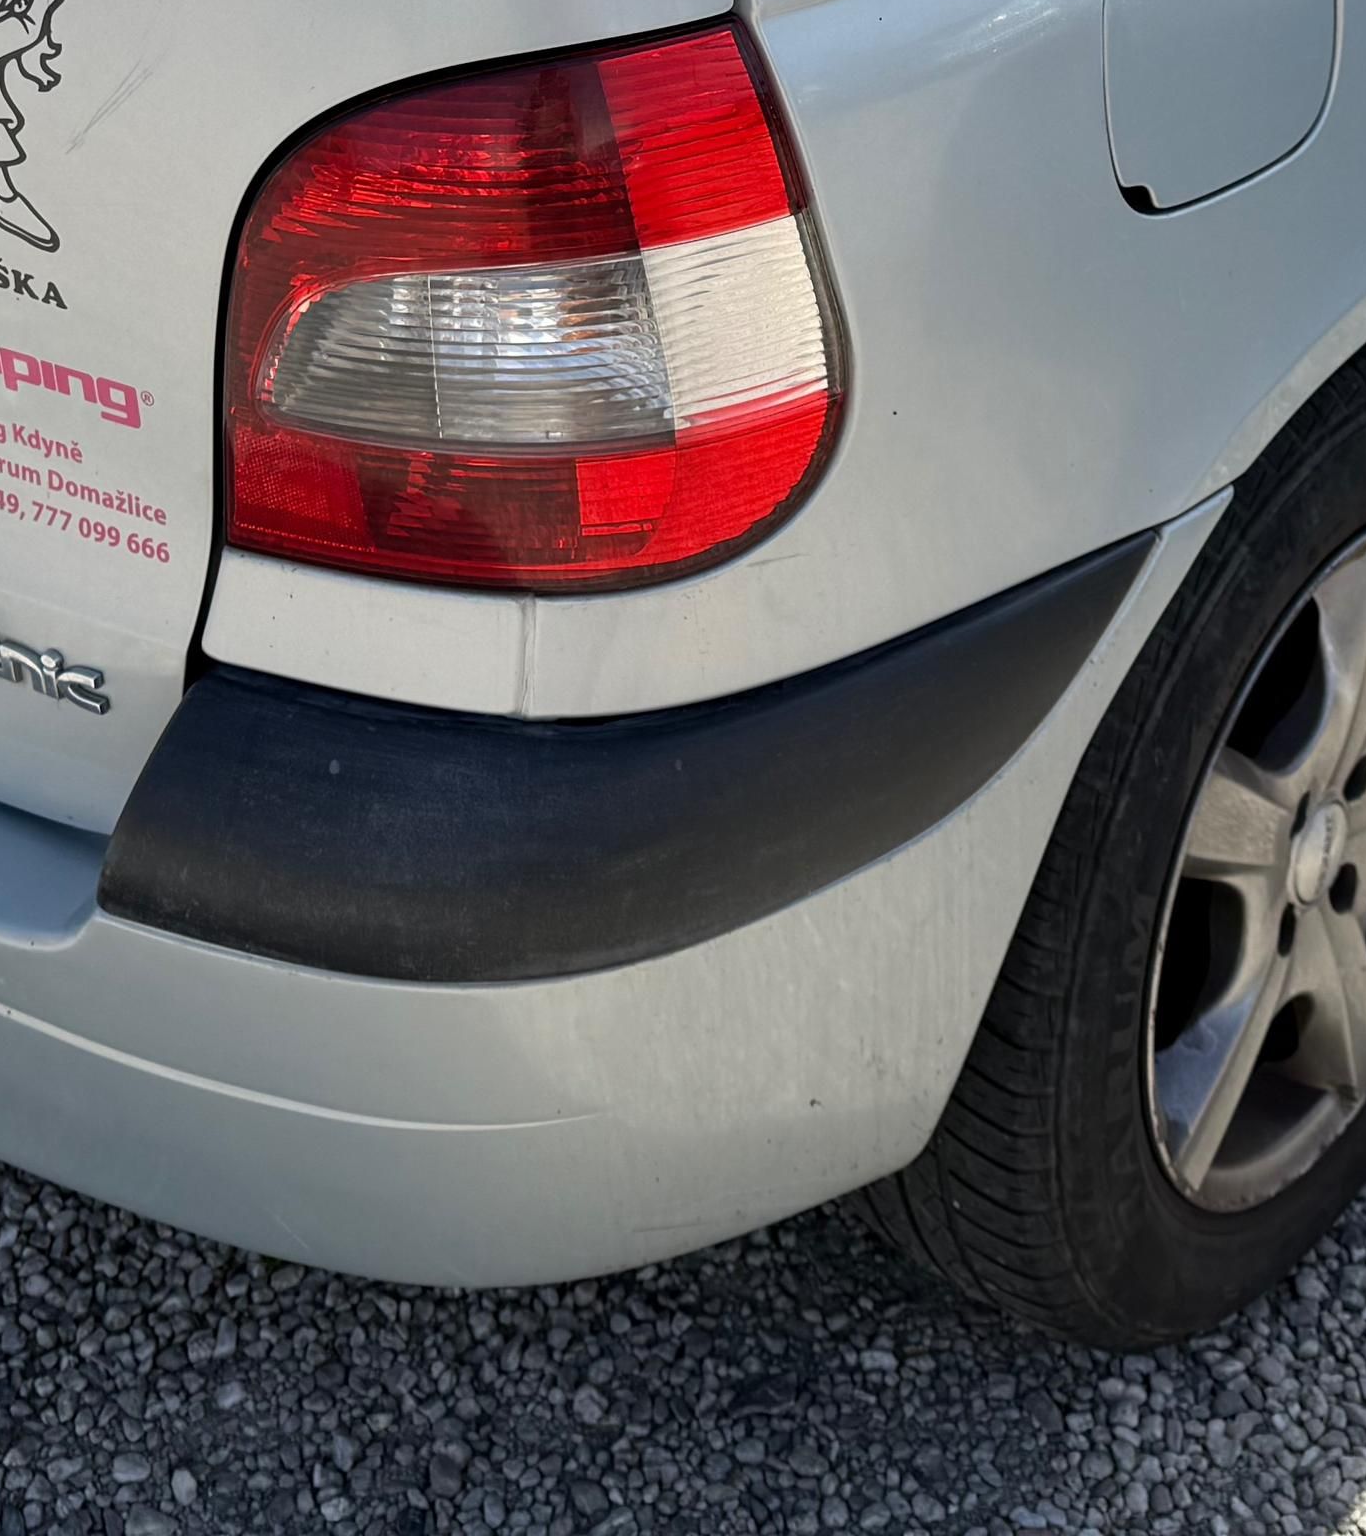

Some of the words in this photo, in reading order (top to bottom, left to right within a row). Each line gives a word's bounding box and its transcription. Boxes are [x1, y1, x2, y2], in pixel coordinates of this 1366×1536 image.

[12, 423, 83, 463] Kdyně
[48, 469, 167, 525] Domažlice
[32, 501, 72, 531] 777
[79, 517, 120, 547] 099
[127, 533, 170, 563] 666
